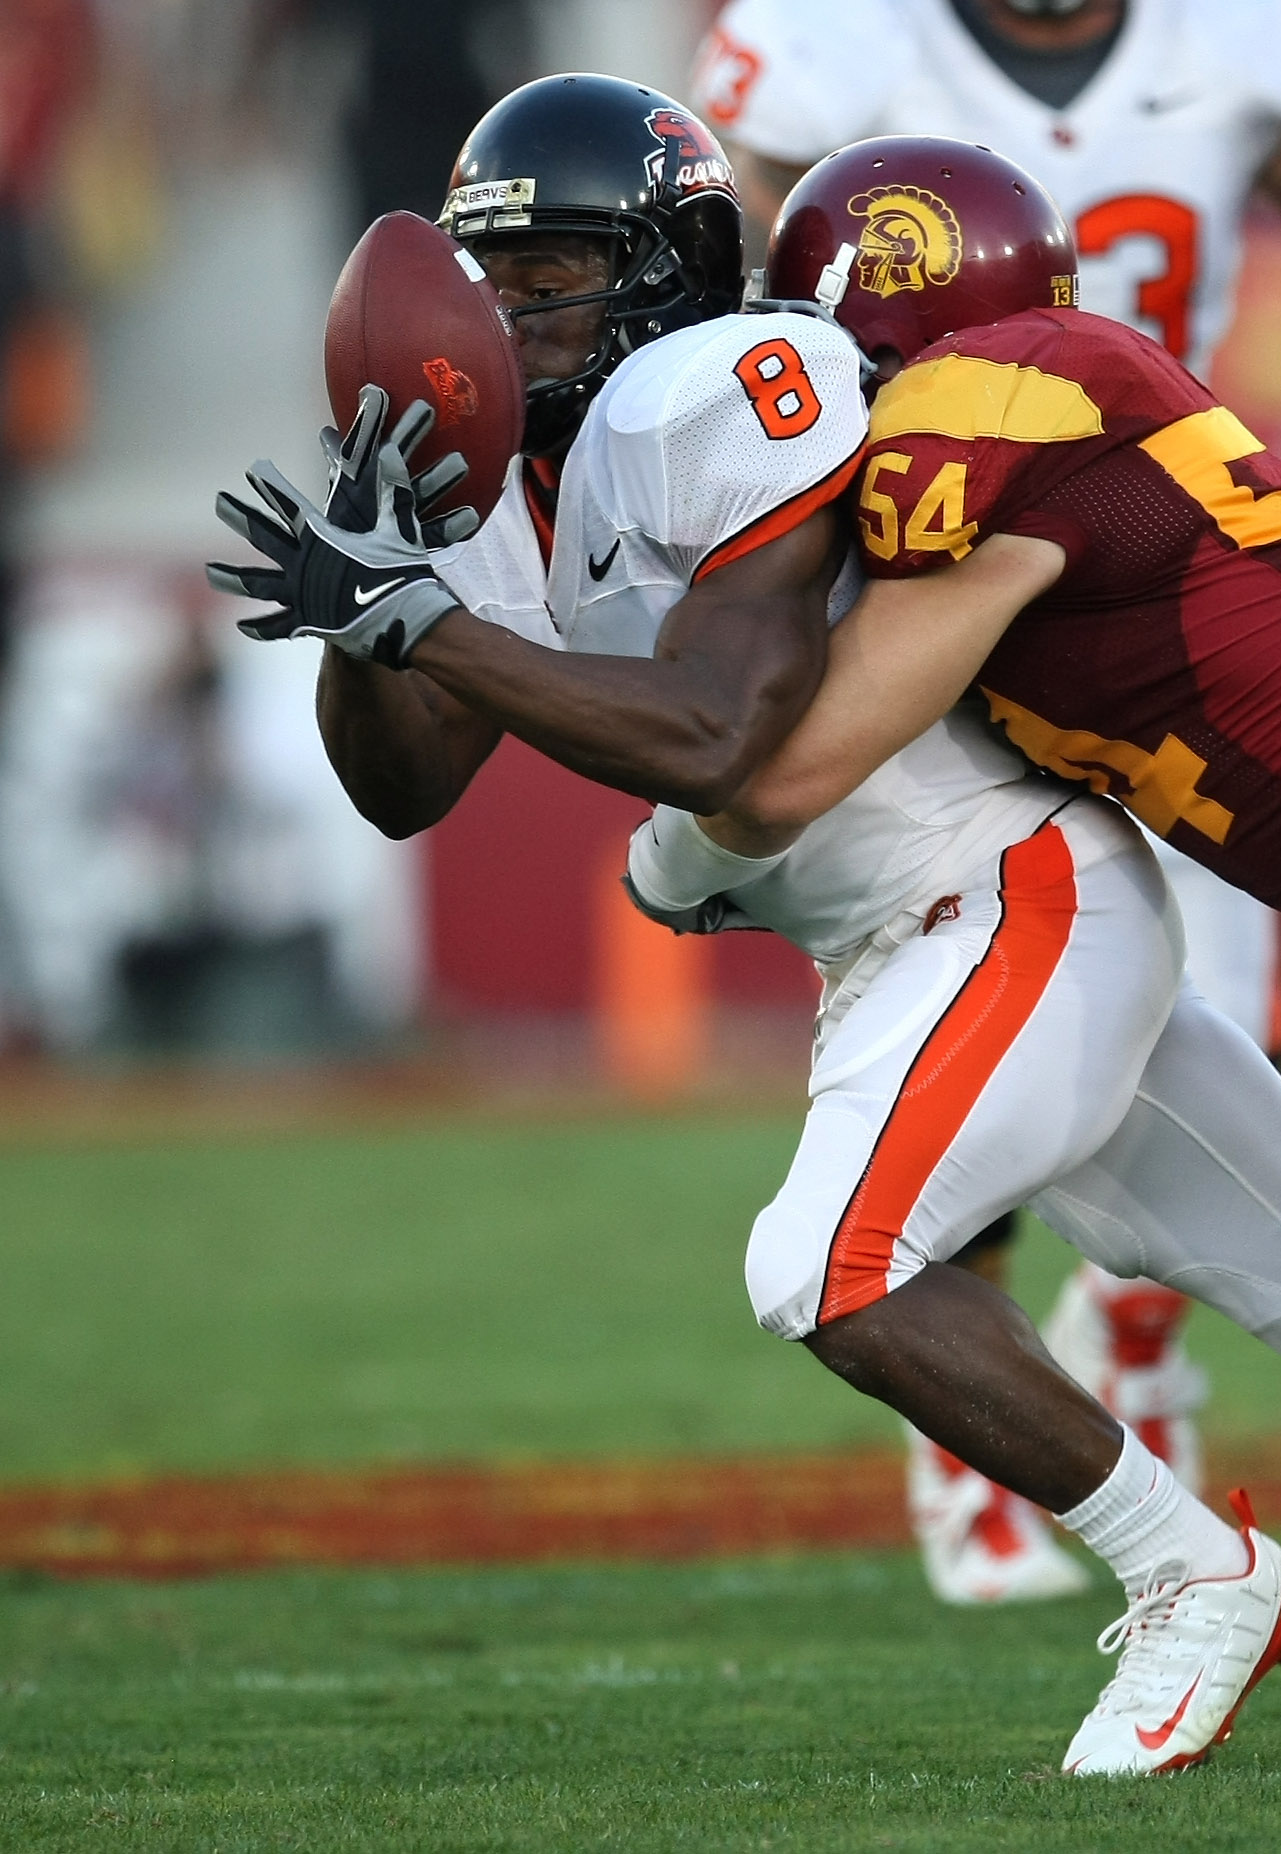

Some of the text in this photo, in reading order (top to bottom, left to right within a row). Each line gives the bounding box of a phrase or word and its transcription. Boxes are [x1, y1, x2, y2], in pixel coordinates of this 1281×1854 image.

[1053, 287, 1070, 306] 13
[732, 338, 822, 440] 8
[858, 451, 979, 561] 54
